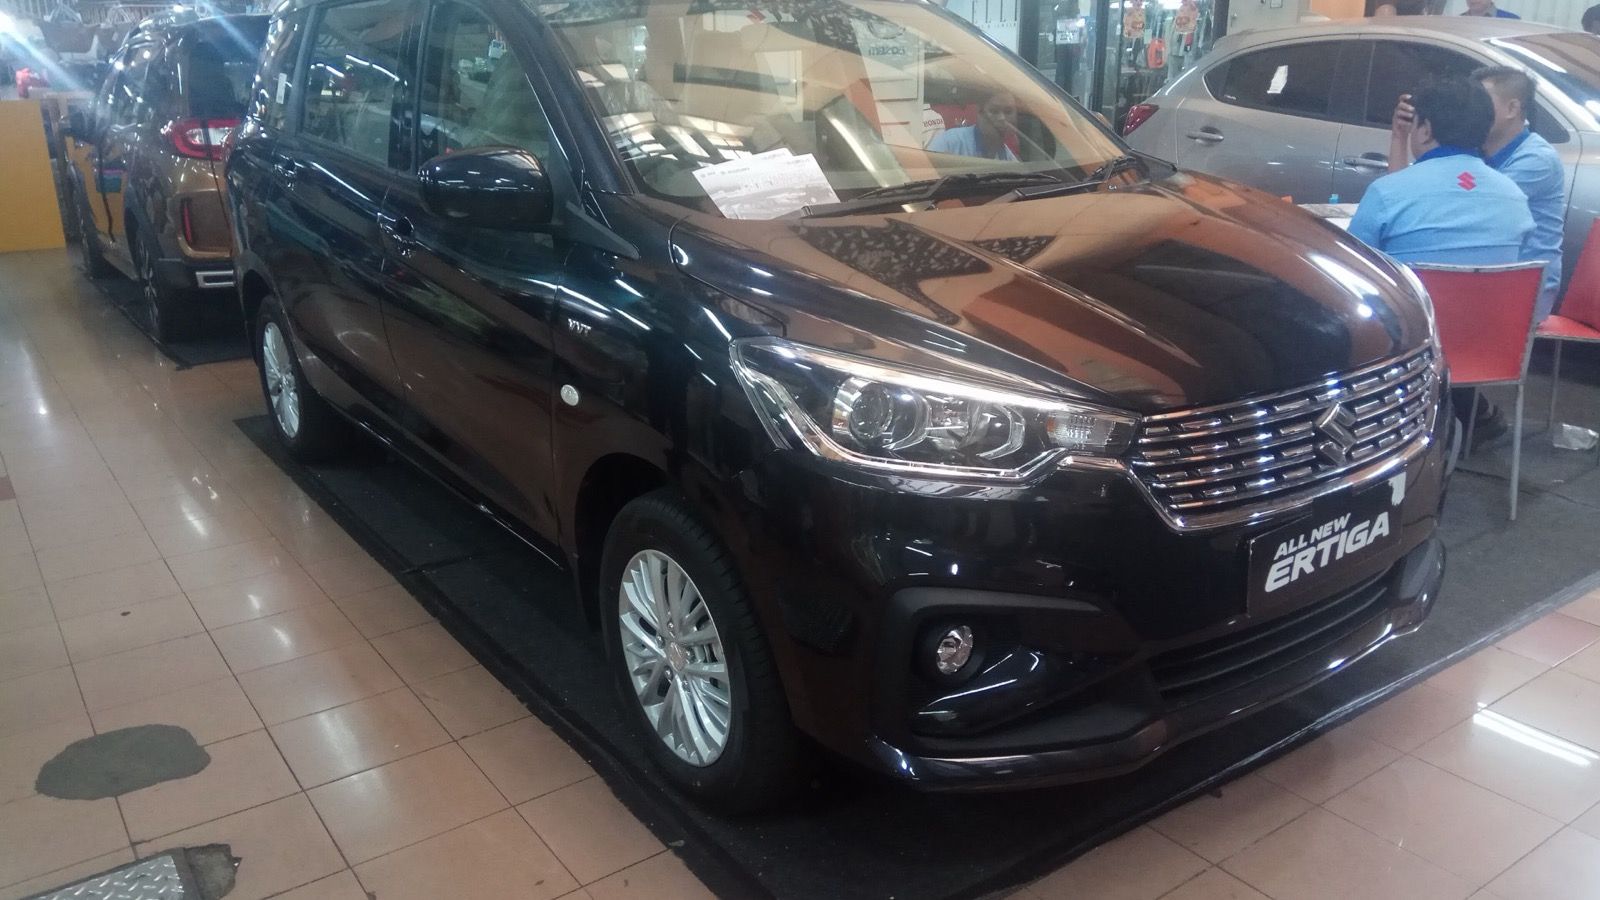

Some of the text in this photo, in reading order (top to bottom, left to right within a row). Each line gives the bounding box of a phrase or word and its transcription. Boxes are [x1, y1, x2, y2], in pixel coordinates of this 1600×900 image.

[1264, 511, 1390, 593] ERTIGA
[1273, 513, 1351, 560] ALL NEW
